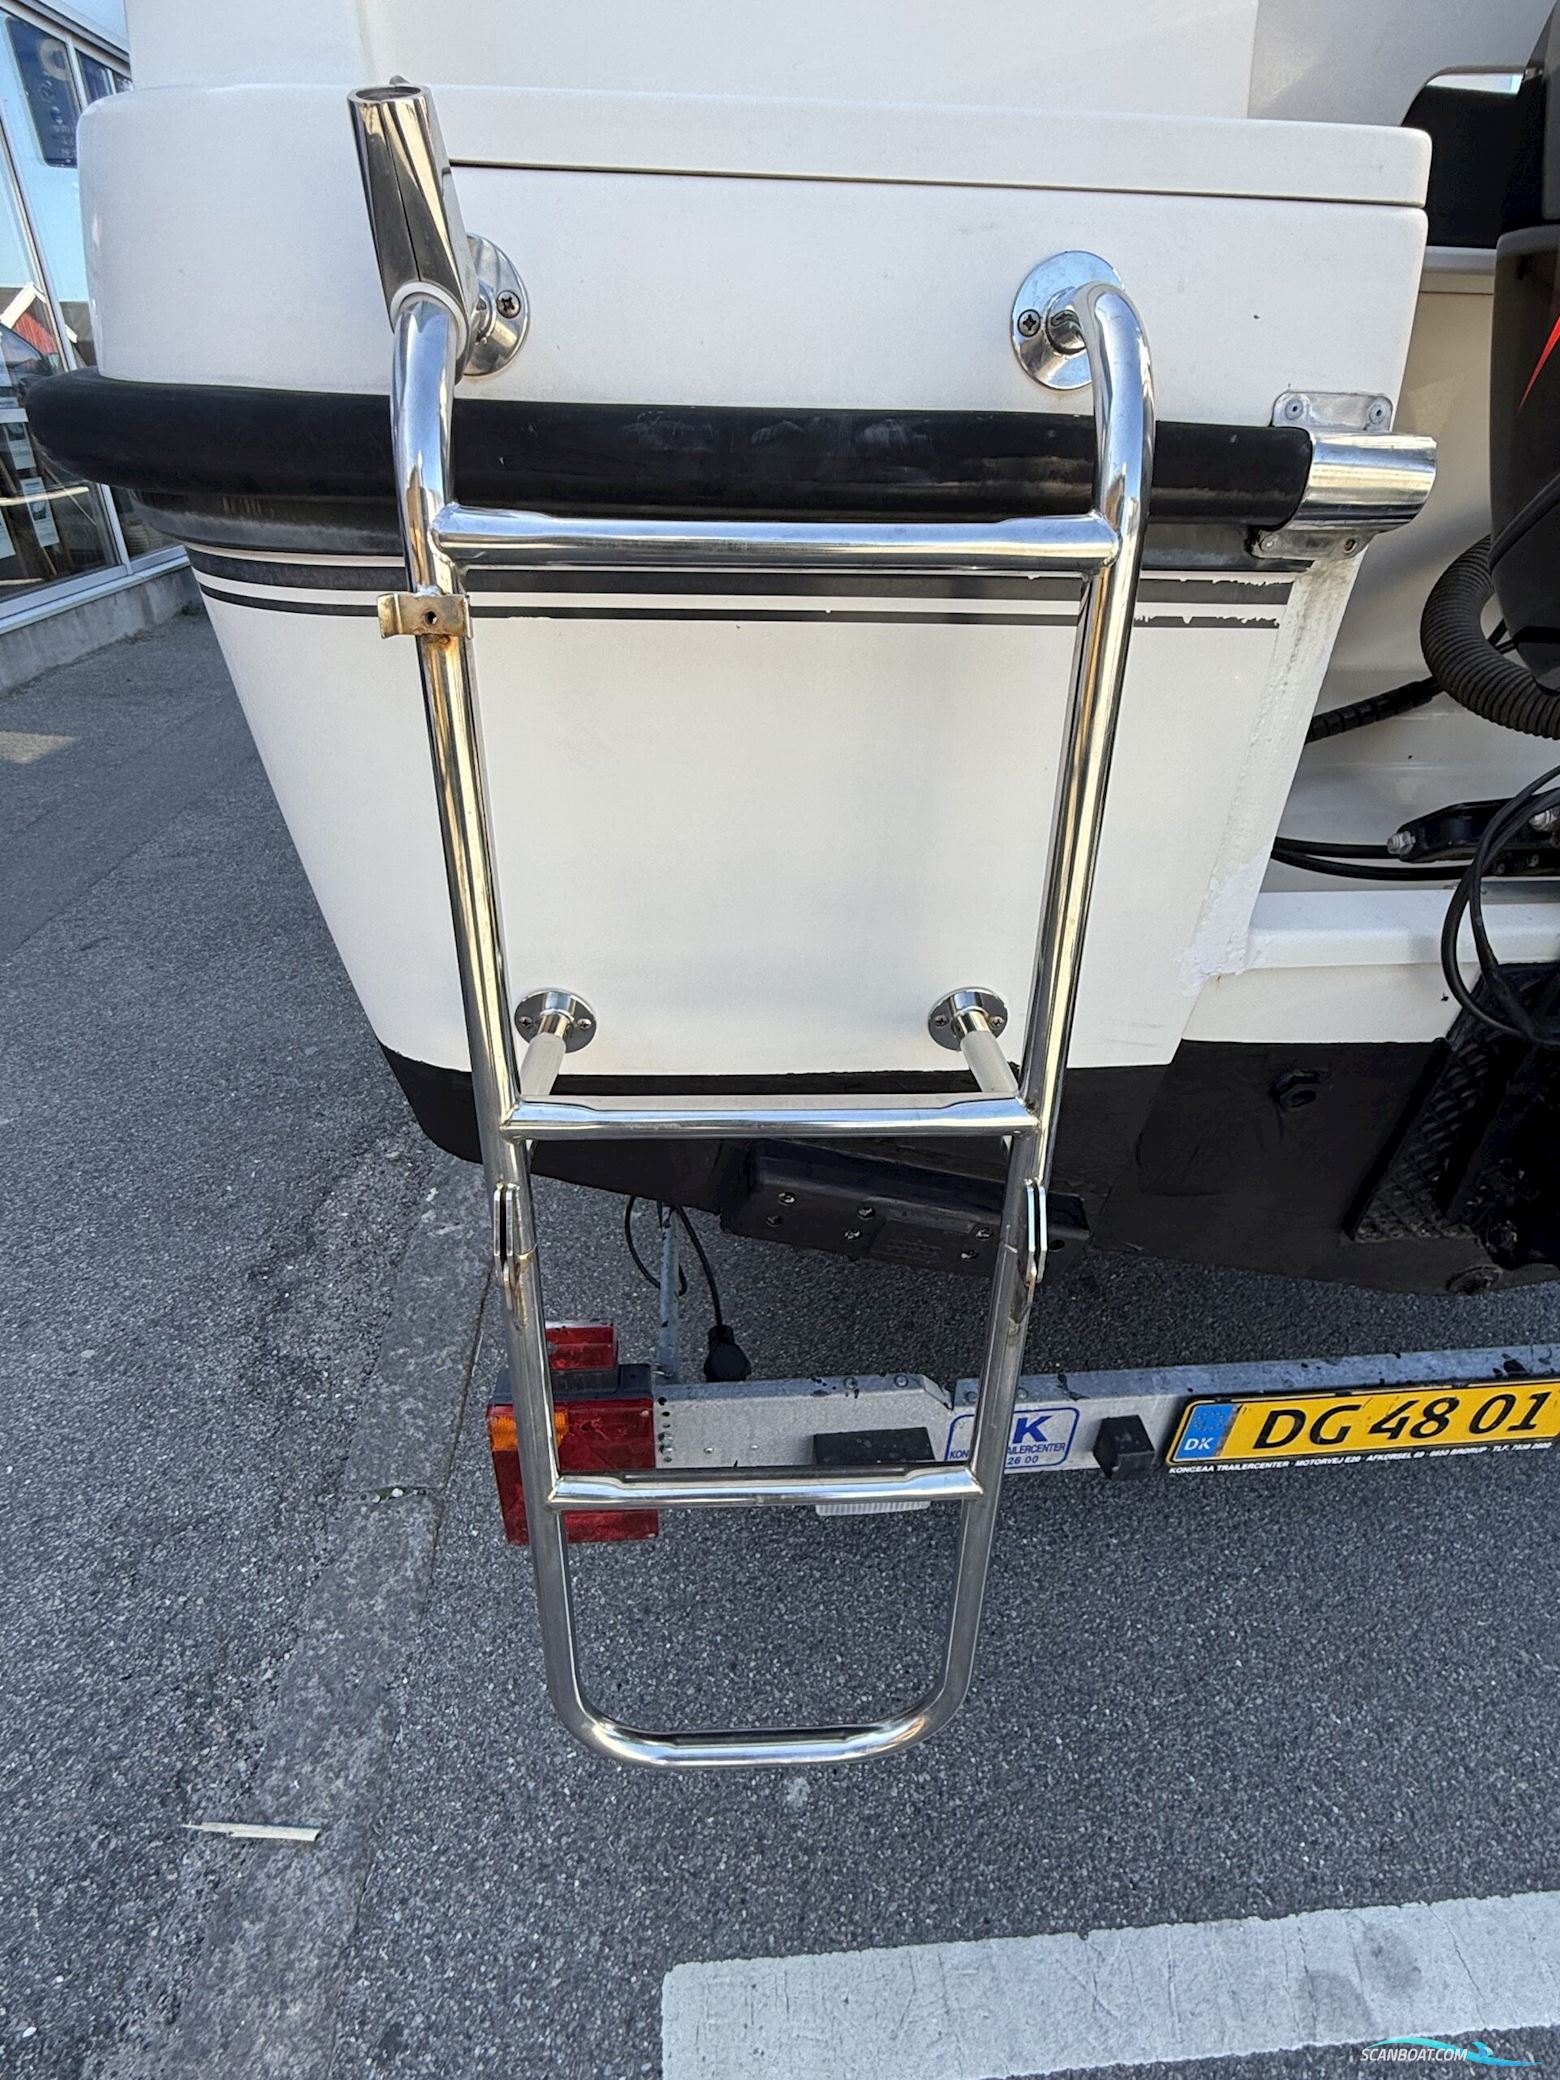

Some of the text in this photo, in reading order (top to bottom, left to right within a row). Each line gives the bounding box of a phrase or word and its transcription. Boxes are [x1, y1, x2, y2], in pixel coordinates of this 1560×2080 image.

[1253, 1391, 1552, 1450] DG 48 01
[1007, 1443, 1066, 1454] AILERCENTER
[1183, 1437, 1211, 1452] DK
[1024, 1455, 1039, 1464] 00
[1216, 1460, 1290, 1472] TRAILERCENTER
[1294, 1457, 1344, 1467] MOTORVEJ
